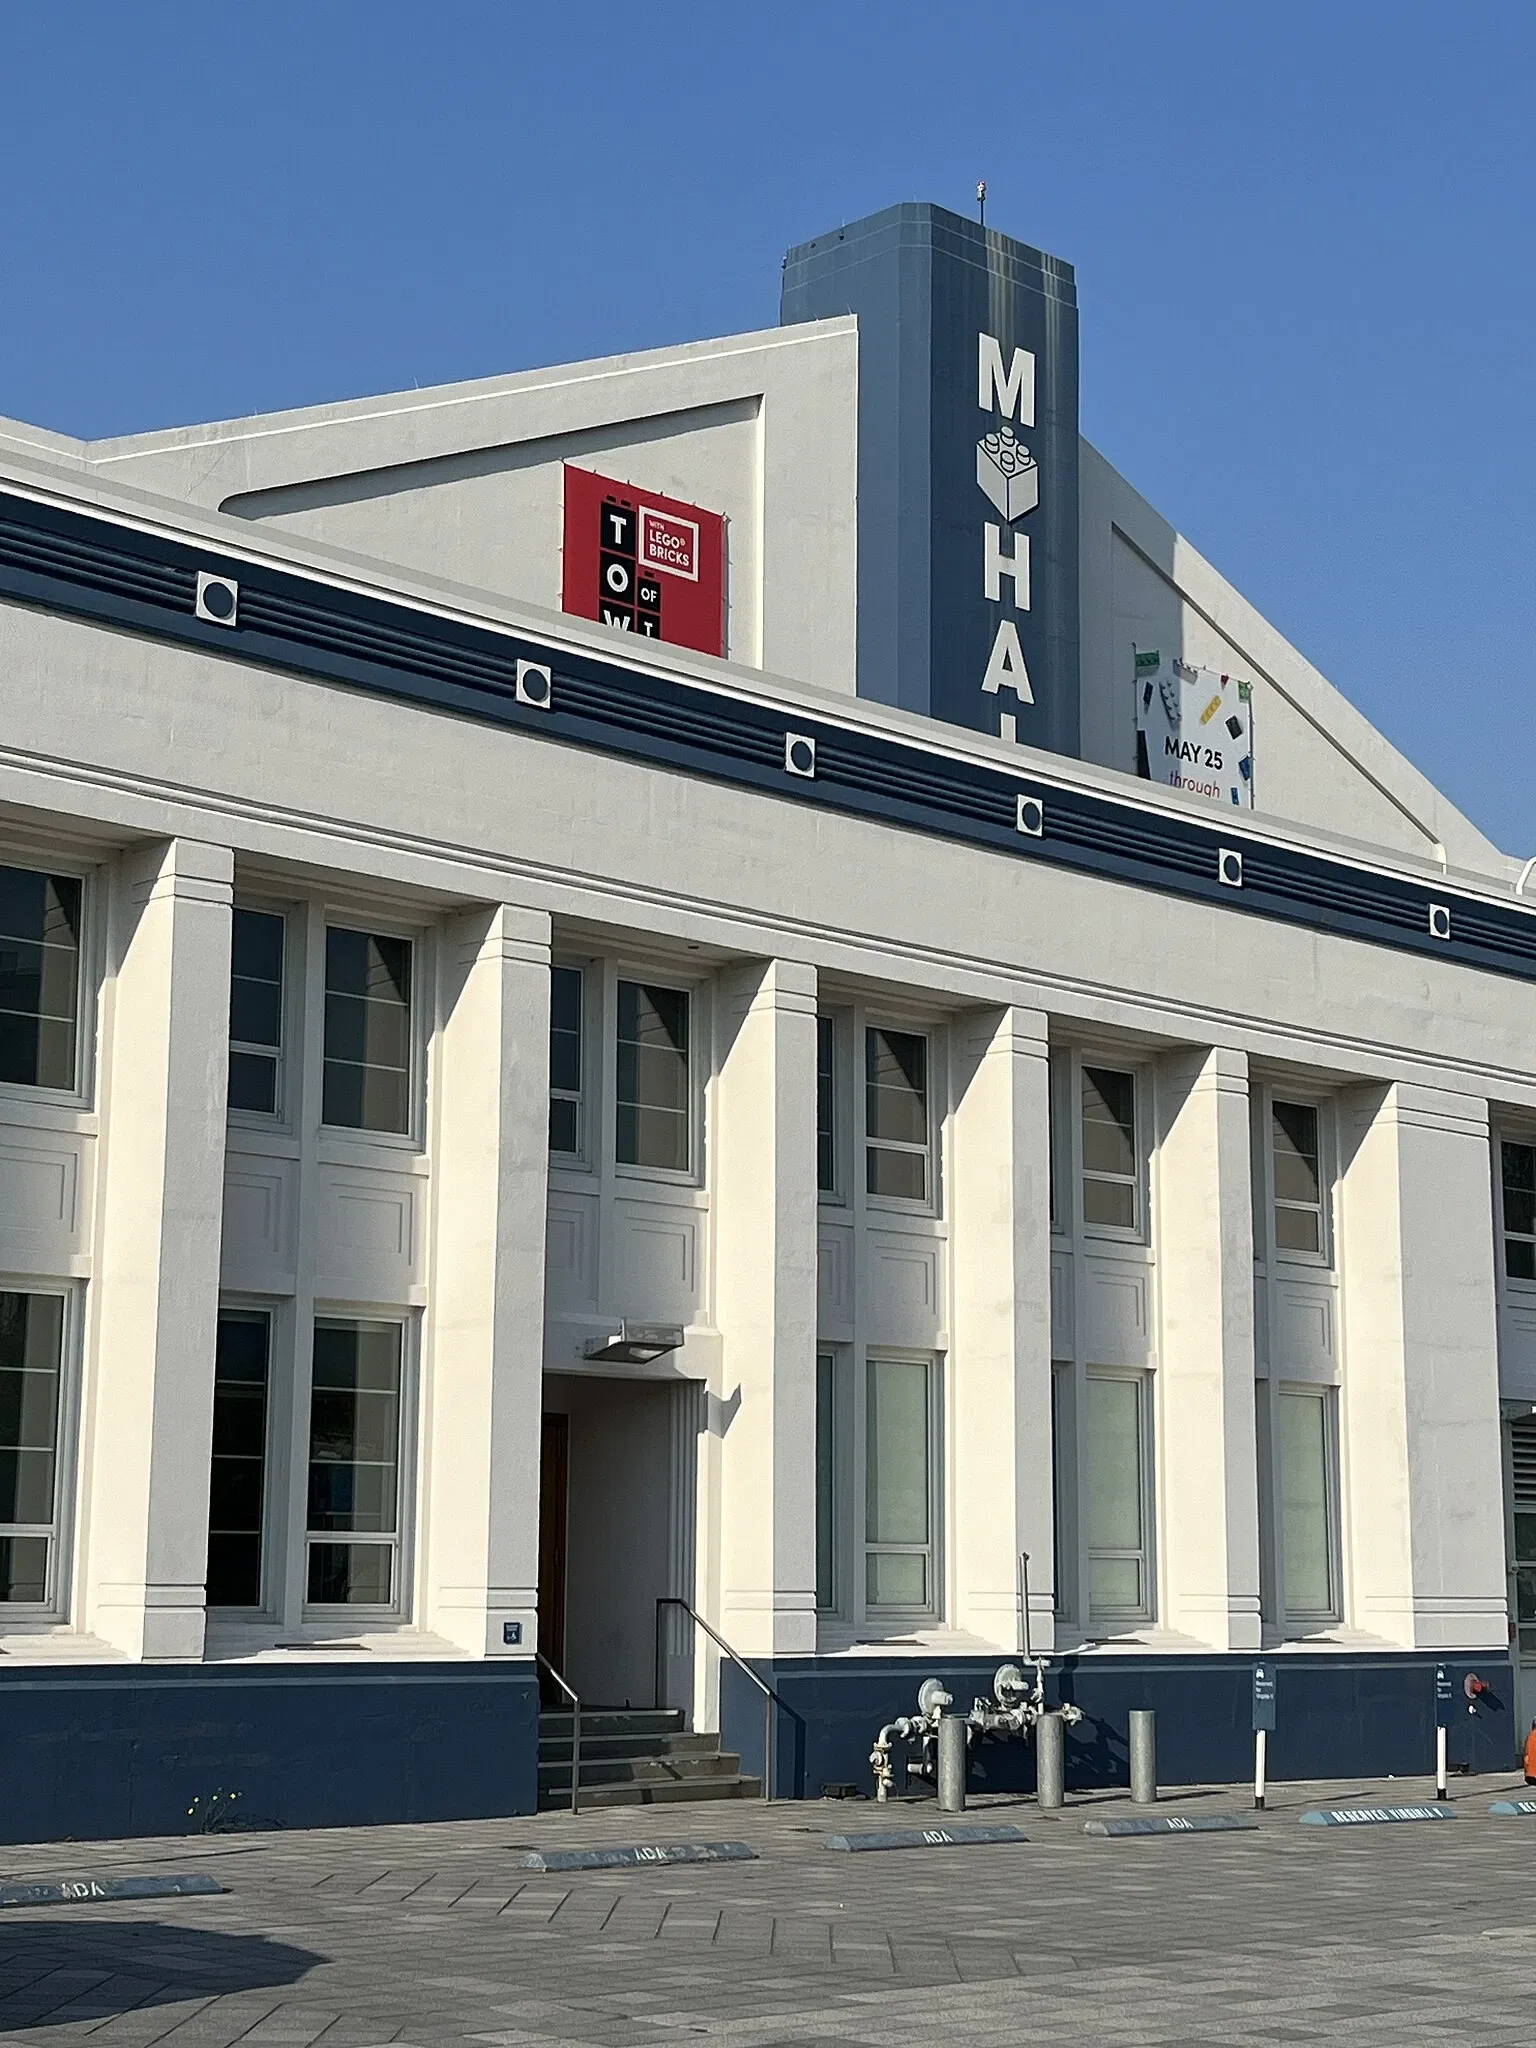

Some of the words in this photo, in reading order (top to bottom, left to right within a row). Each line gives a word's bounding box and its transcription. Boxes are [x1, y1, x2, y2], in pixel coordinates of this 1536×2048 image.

[649, 519, 665, 531] WITH
[649, 545, 690, 566] BRICKS
[640, 587, 658, 603] OF
[1164, 735, 1202, 763] MAY
[1204, 748, 1223, 770] 25
[1170, 770, 1221, 798] through
[1166, 1817, 1194, 1829] ADA
[1331, 1809, 1390, 1822] RESERVED
[922, 1830, 953, 1844] ADA
[633, 1846, 667, 1860] ADA
[61, 1881, 105, 1899] ADA
